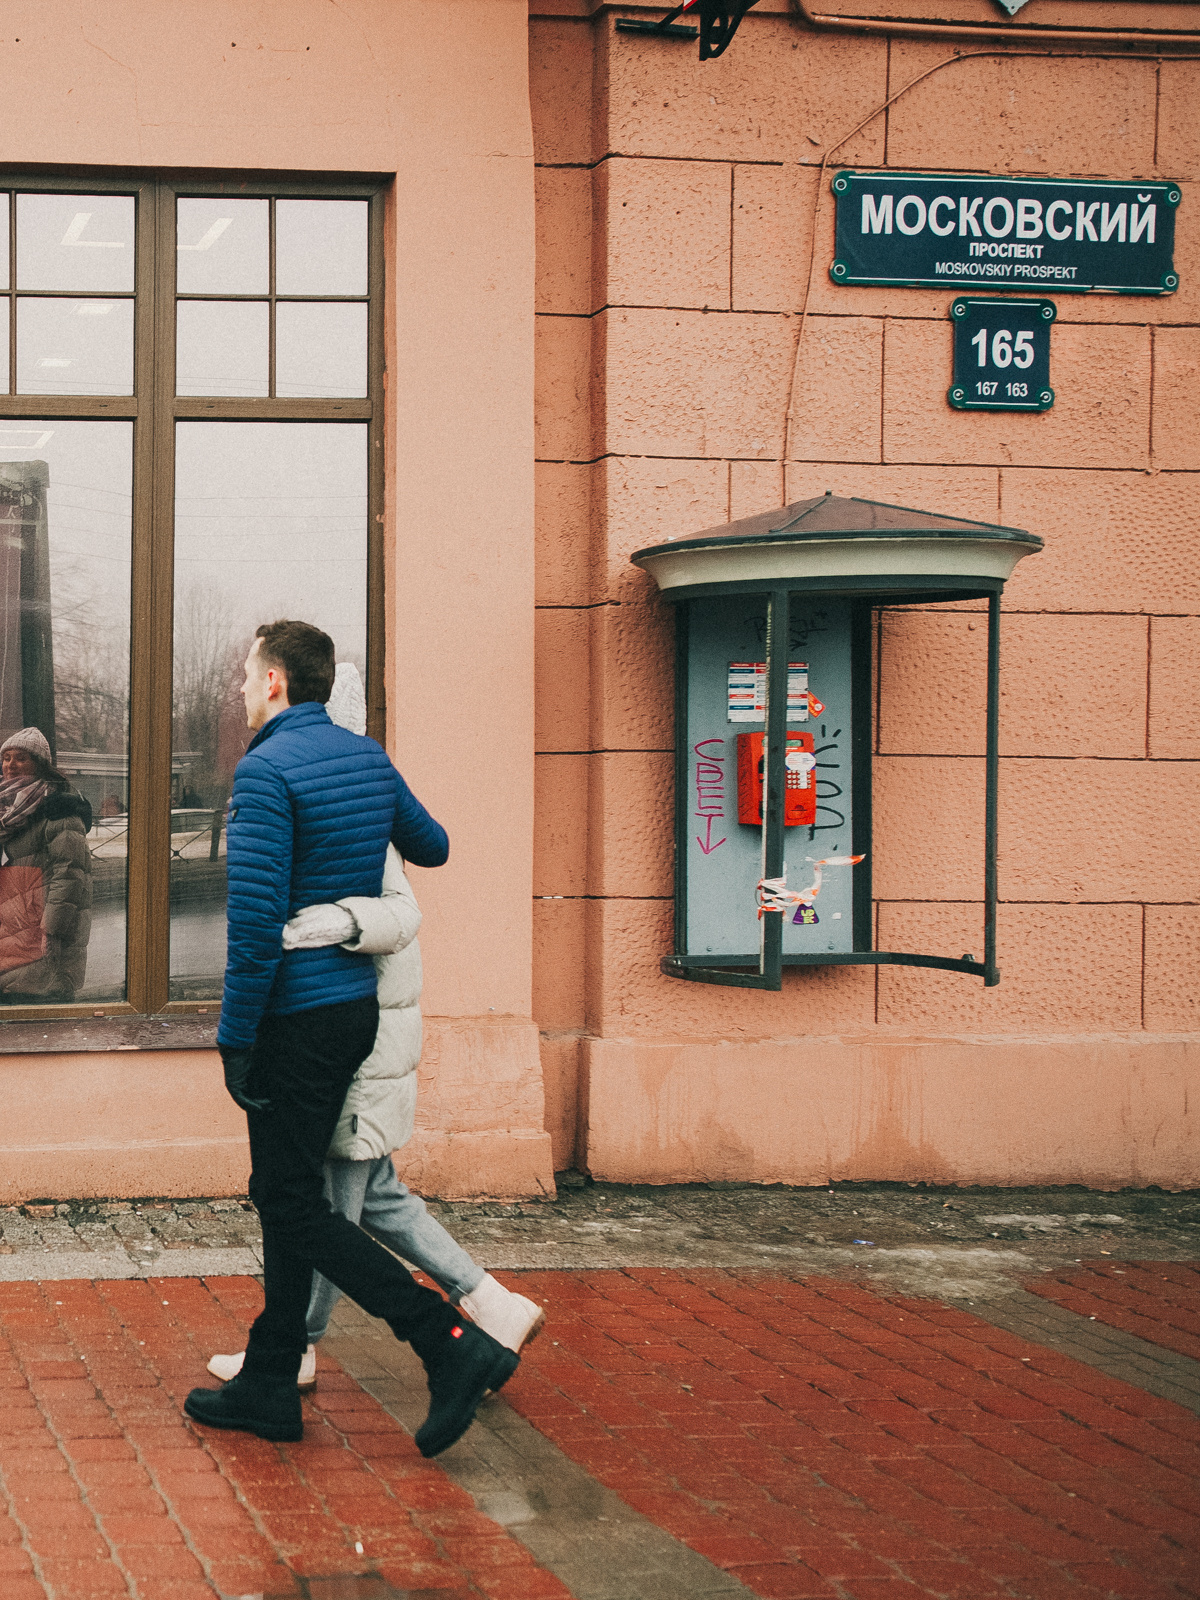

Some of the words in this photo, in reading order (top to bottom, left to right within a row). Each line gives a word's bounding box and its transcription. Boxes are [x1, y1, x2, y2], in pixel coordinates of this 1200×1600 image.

[860, 193, 1157, 244] МОСКОВСКИЙ
[969, 242, 1044, 259] ПРОСПЕКТ
[935, 262, 1013, 276] MOSKOVSKIY
[1013, 264, 1078, 279] PROSPEKT
[971, 328, 1035, 369] 165
[975, 382, 998, 396] 167
[1005, 382, 1029, 397] 163
